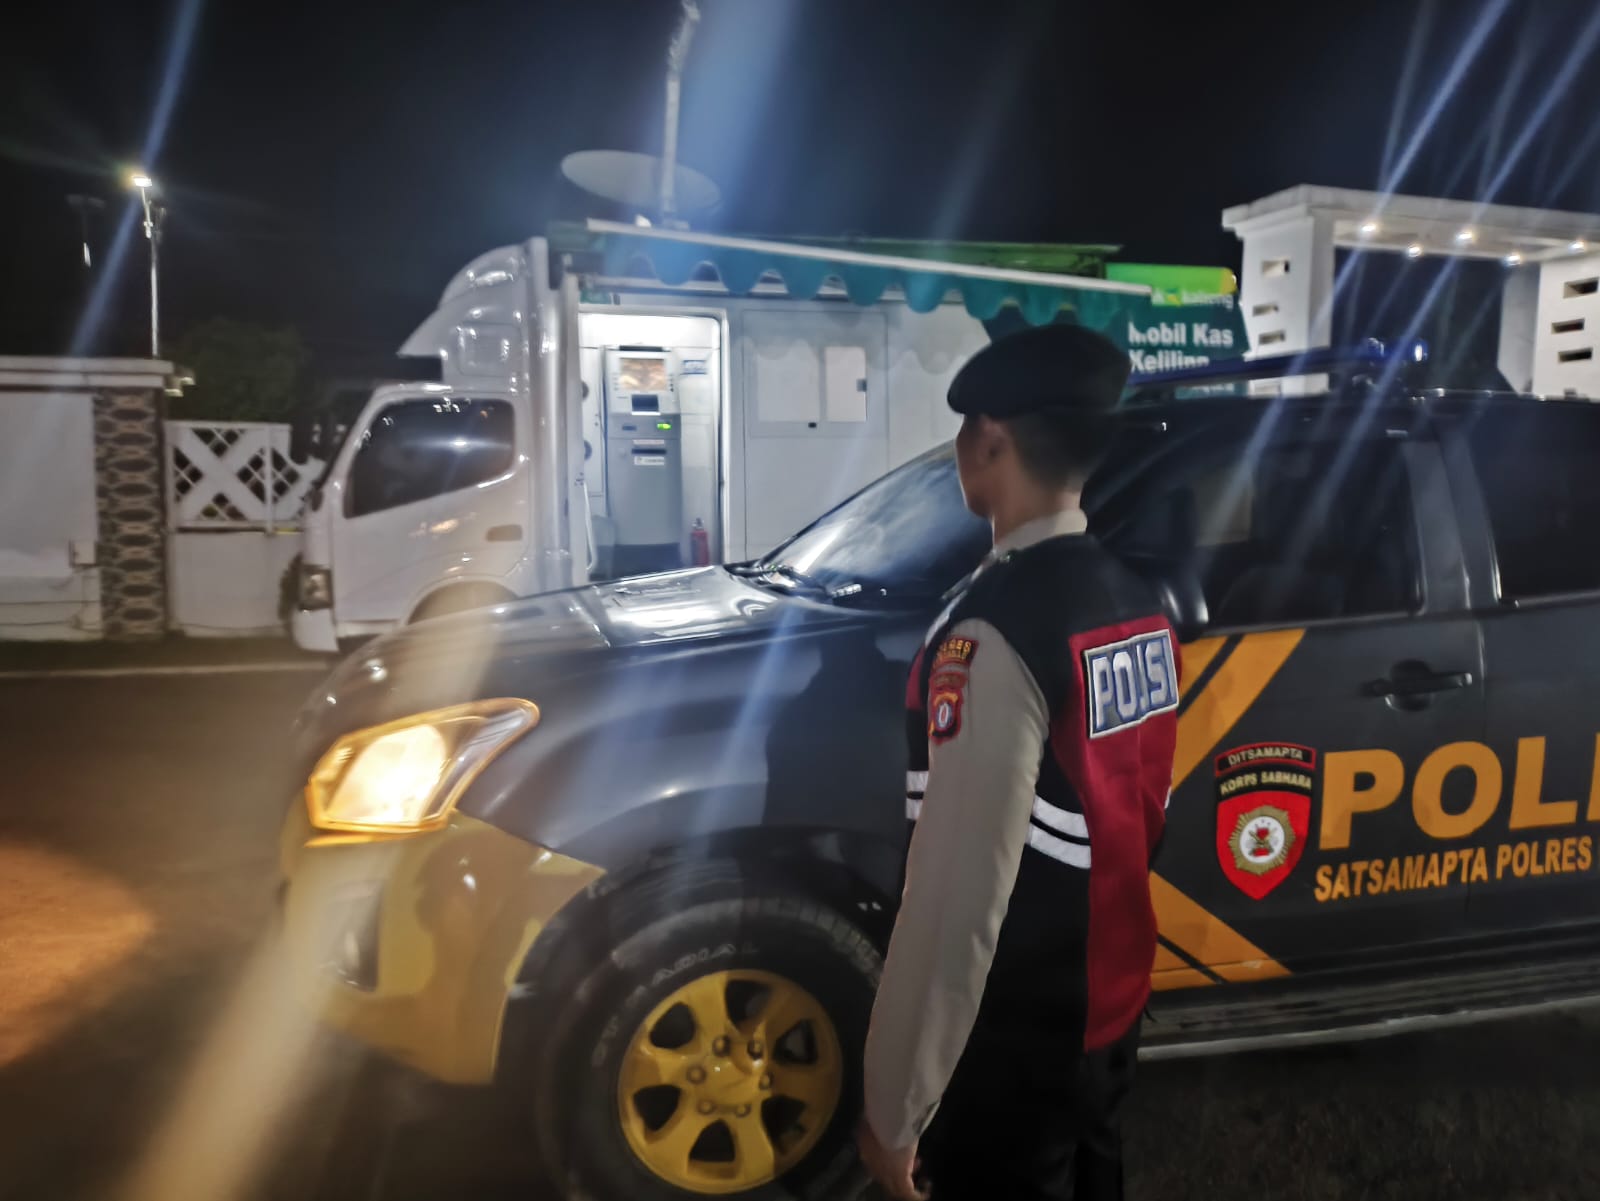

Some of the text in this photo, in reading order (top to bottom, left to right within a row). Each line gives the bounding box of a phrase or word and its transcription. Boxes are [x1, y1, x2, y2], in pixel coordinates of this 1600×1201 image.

[1193, 322, 1234, 348] Kas
[1227, 746, 1304, 767] DITSAMAPTA
[1219, 770, 1312, 796] KORPS SABHARA
[1313, 835, 1593, 902] SATSAMAPTA POLRES
